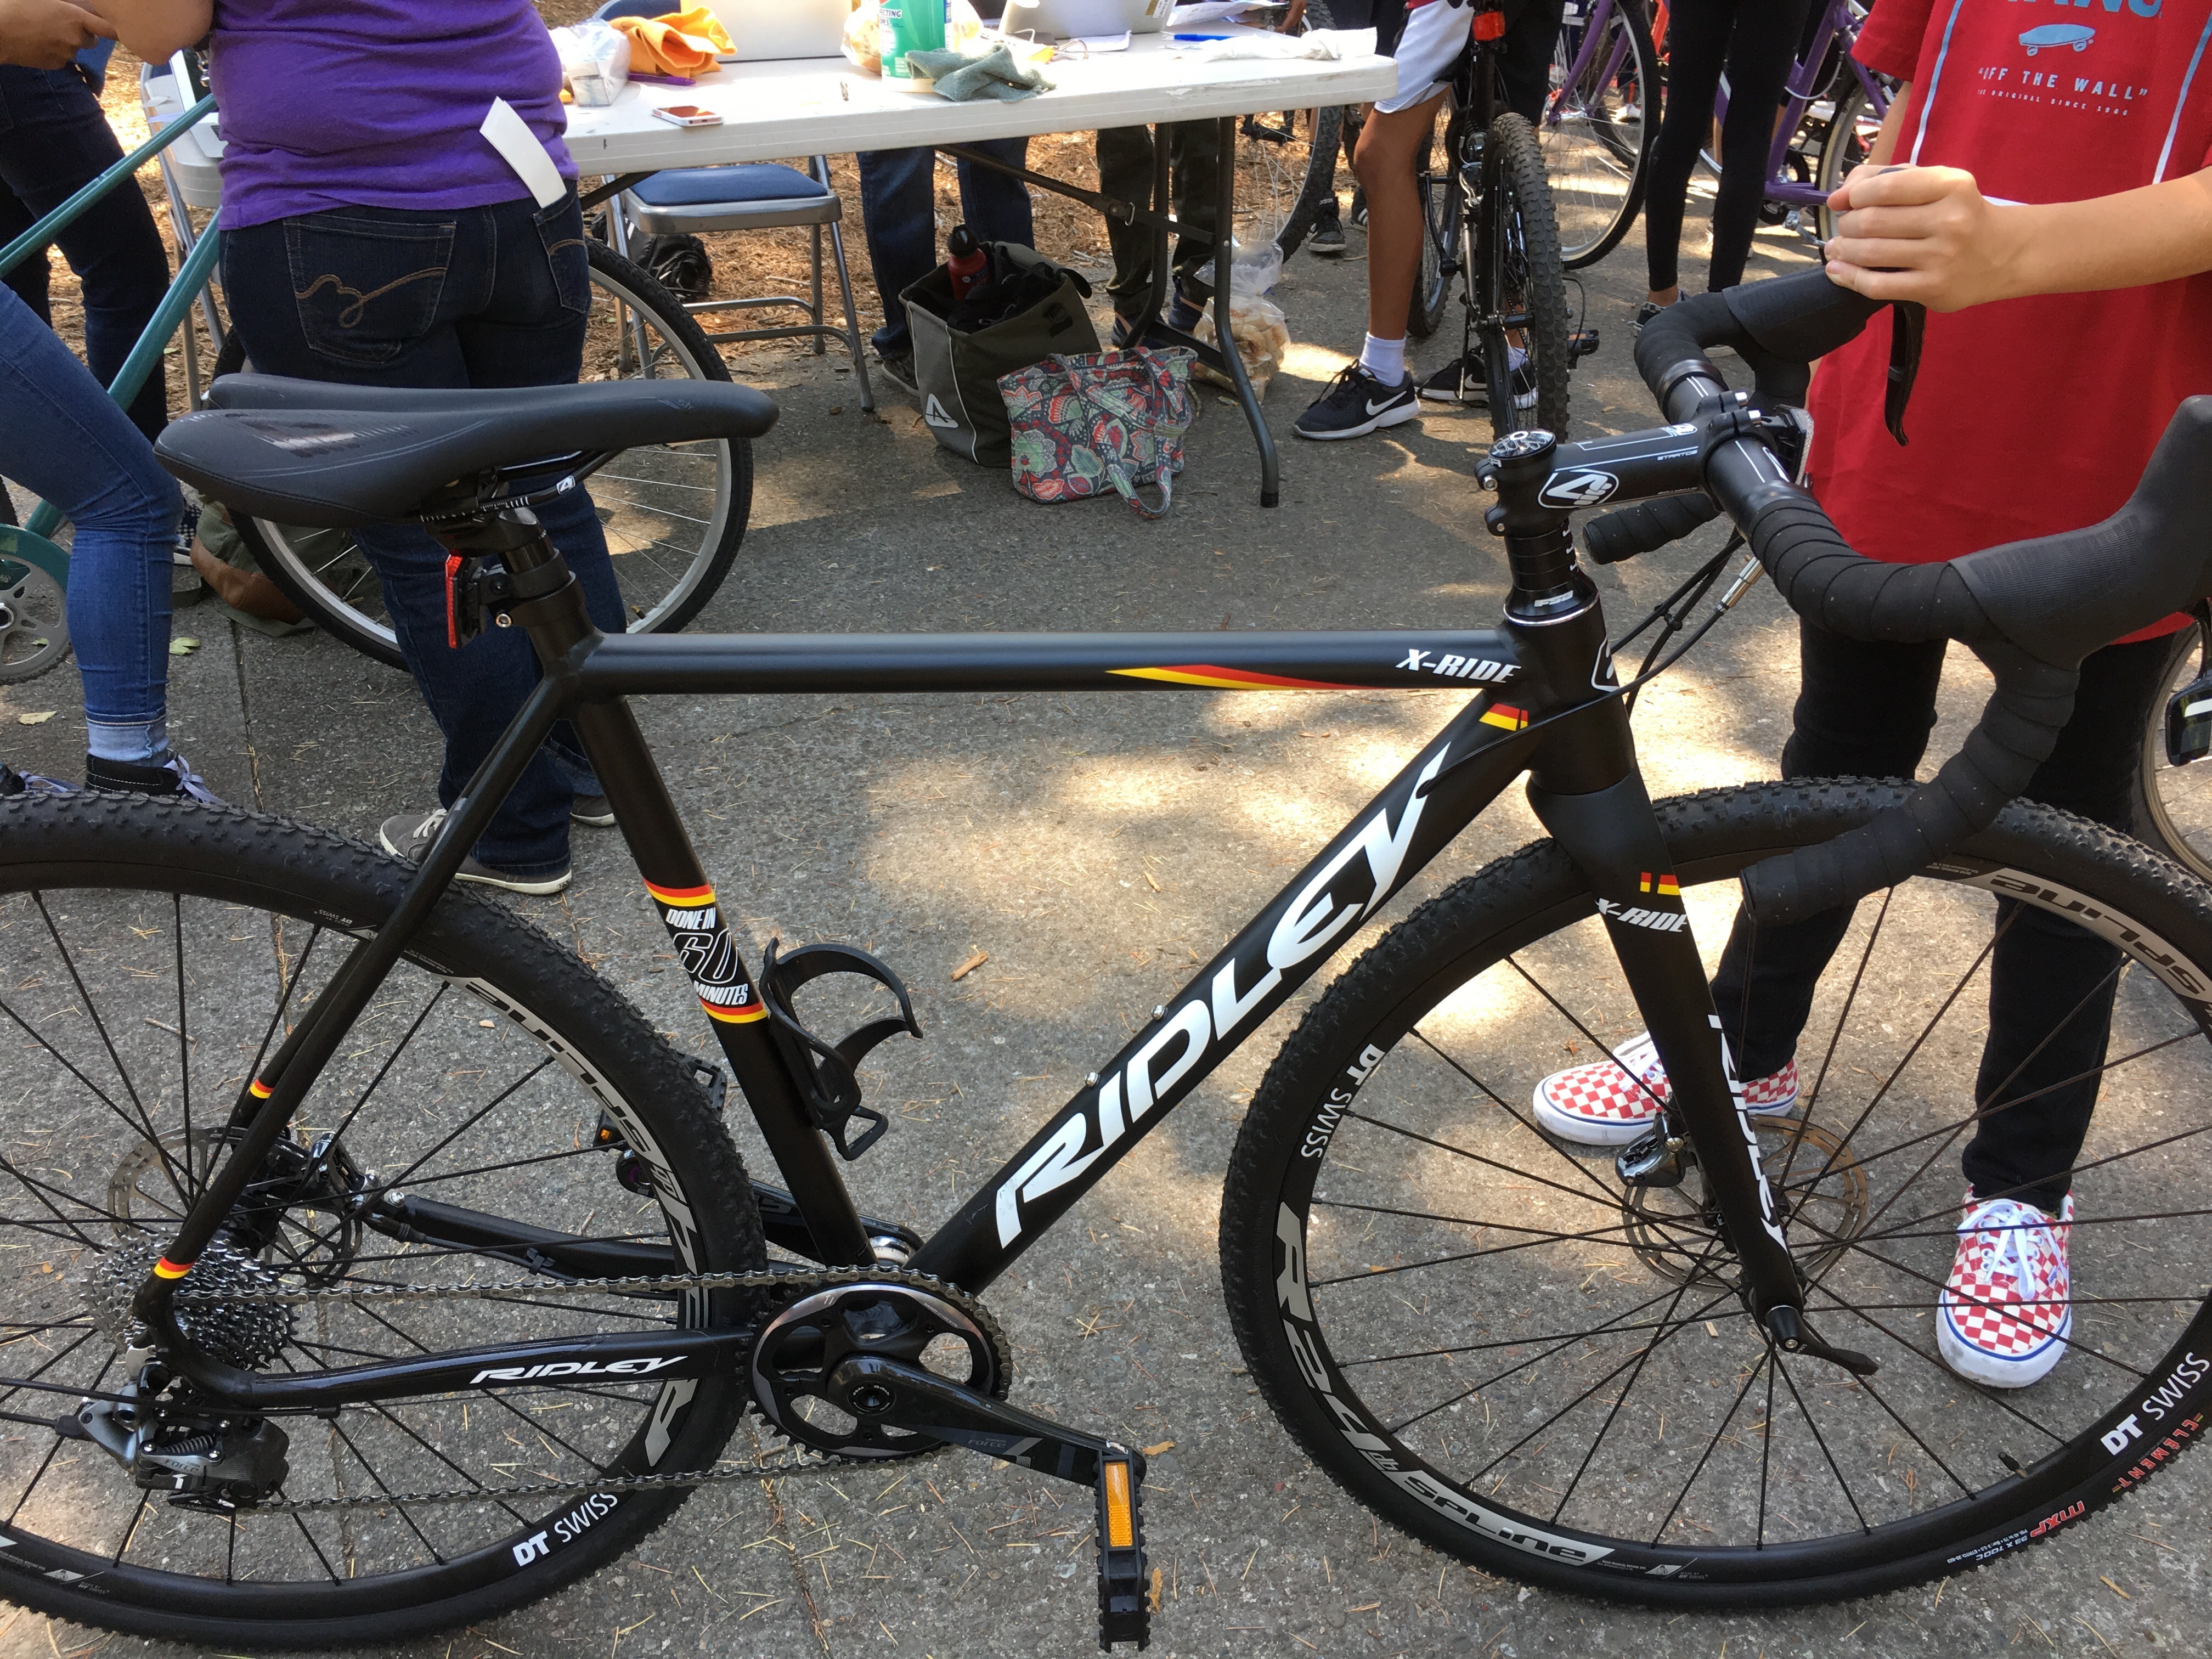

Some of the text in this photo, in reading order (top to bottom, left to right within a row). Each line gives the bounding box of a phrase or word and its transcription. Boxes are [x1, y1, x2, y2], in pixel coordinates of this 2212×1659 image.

[2022, 71, 2058, 88] THE
[1991, 90, 2040, 103] ORIGINAL
[2051, 99, 2086, 110] SINCE
[1657, 449, 1699, 460] STRATOS
[1395, 649, 1522, 683] X-RIDE
[666, 907, 716, 930] DONE IN
[1594, 898, 1688, 932] X-RIDE
[673, 928, 741, 984] 60
[694, 980, 748, 1005] MINUTES
[996, 741, 1451, 1249] RIDLEY
[1301, 1043, 1385, 1158] DT SWISS
[469, 1356, 689, 1384] RIDLEY
[2100, 1413, 2143, 1455] DT
[2142, 1352, 2210, 1421] SWISS
[2118, 1419, 2199, 1488] CLEMENT
[512, 1493, 618, 1567] DT SWISS
[1976, 1547, 2005, 1561] 700C
